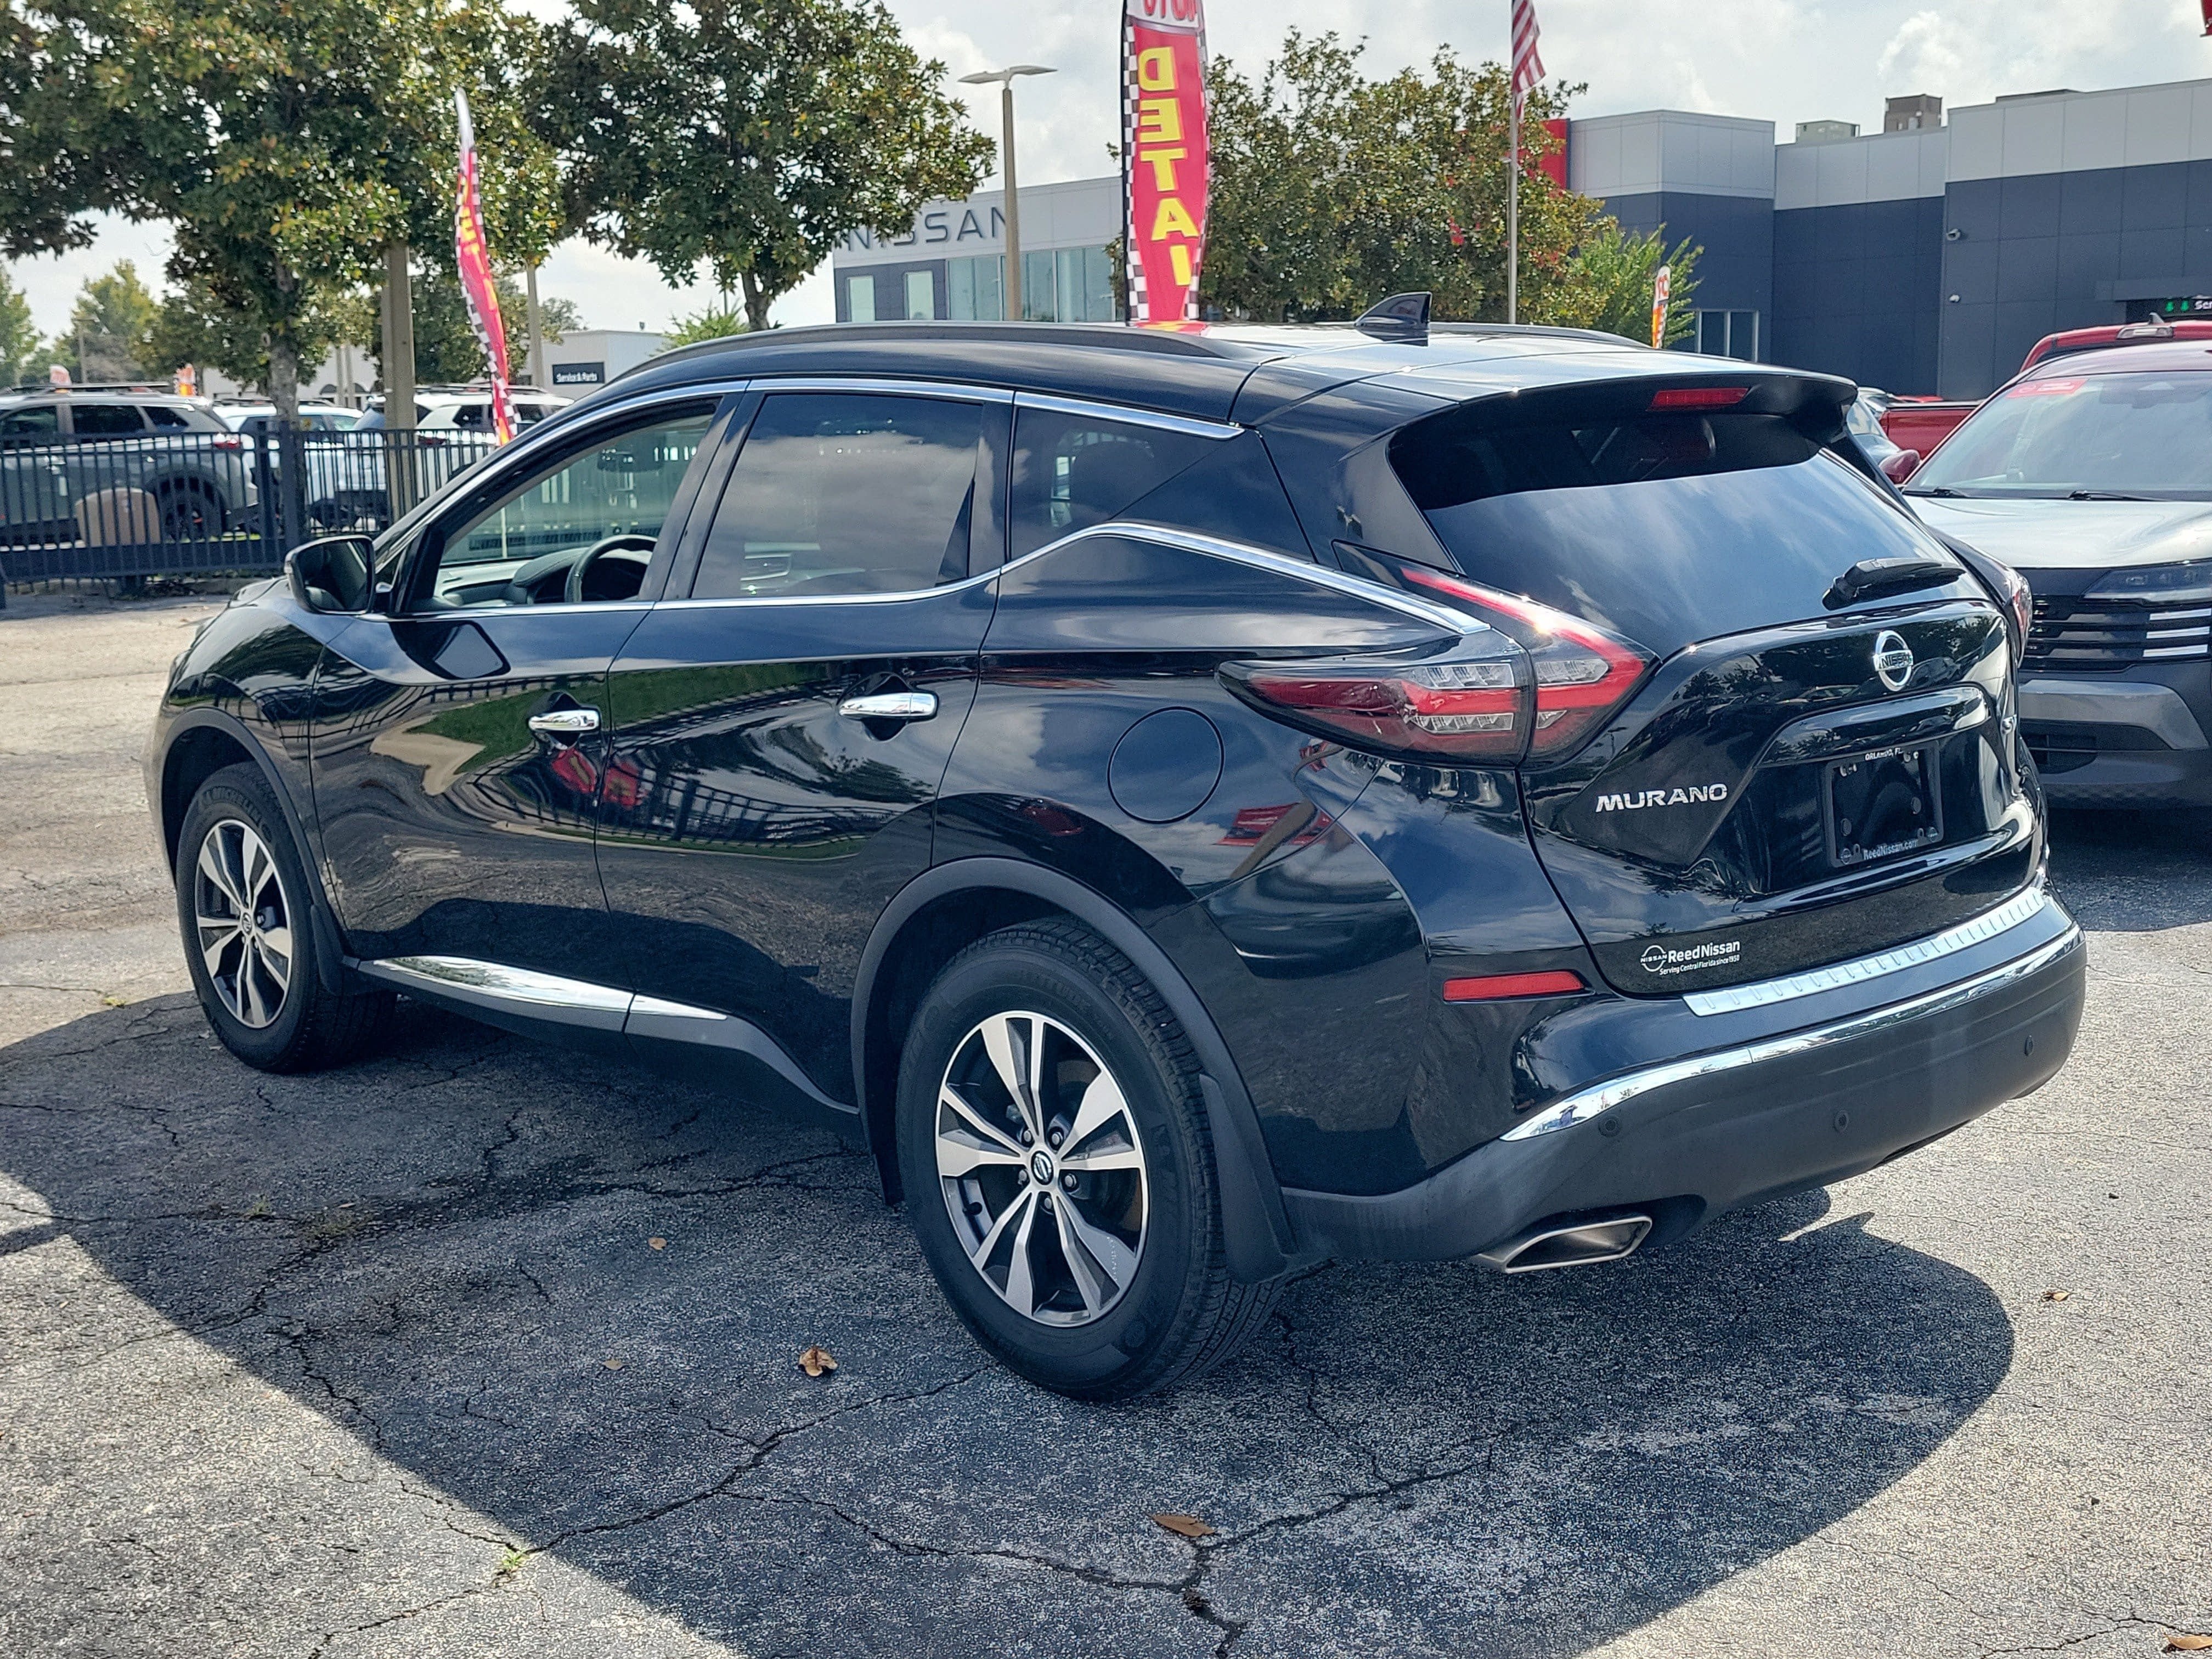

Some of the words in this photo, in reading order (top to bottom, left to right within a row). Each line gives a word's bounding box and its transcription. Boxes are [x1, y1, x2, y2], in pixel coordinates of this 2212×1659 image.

[1595, 783, 1728, 812] MURANO
[1640, 954, 1667, 962] NISSAN
[1659, 966, 1680, 975] Serving
[1680, 962, 1699, 972] Central
[1699, 959, 1716, 968] Florida
[1716, 957, 1729, 966] since
